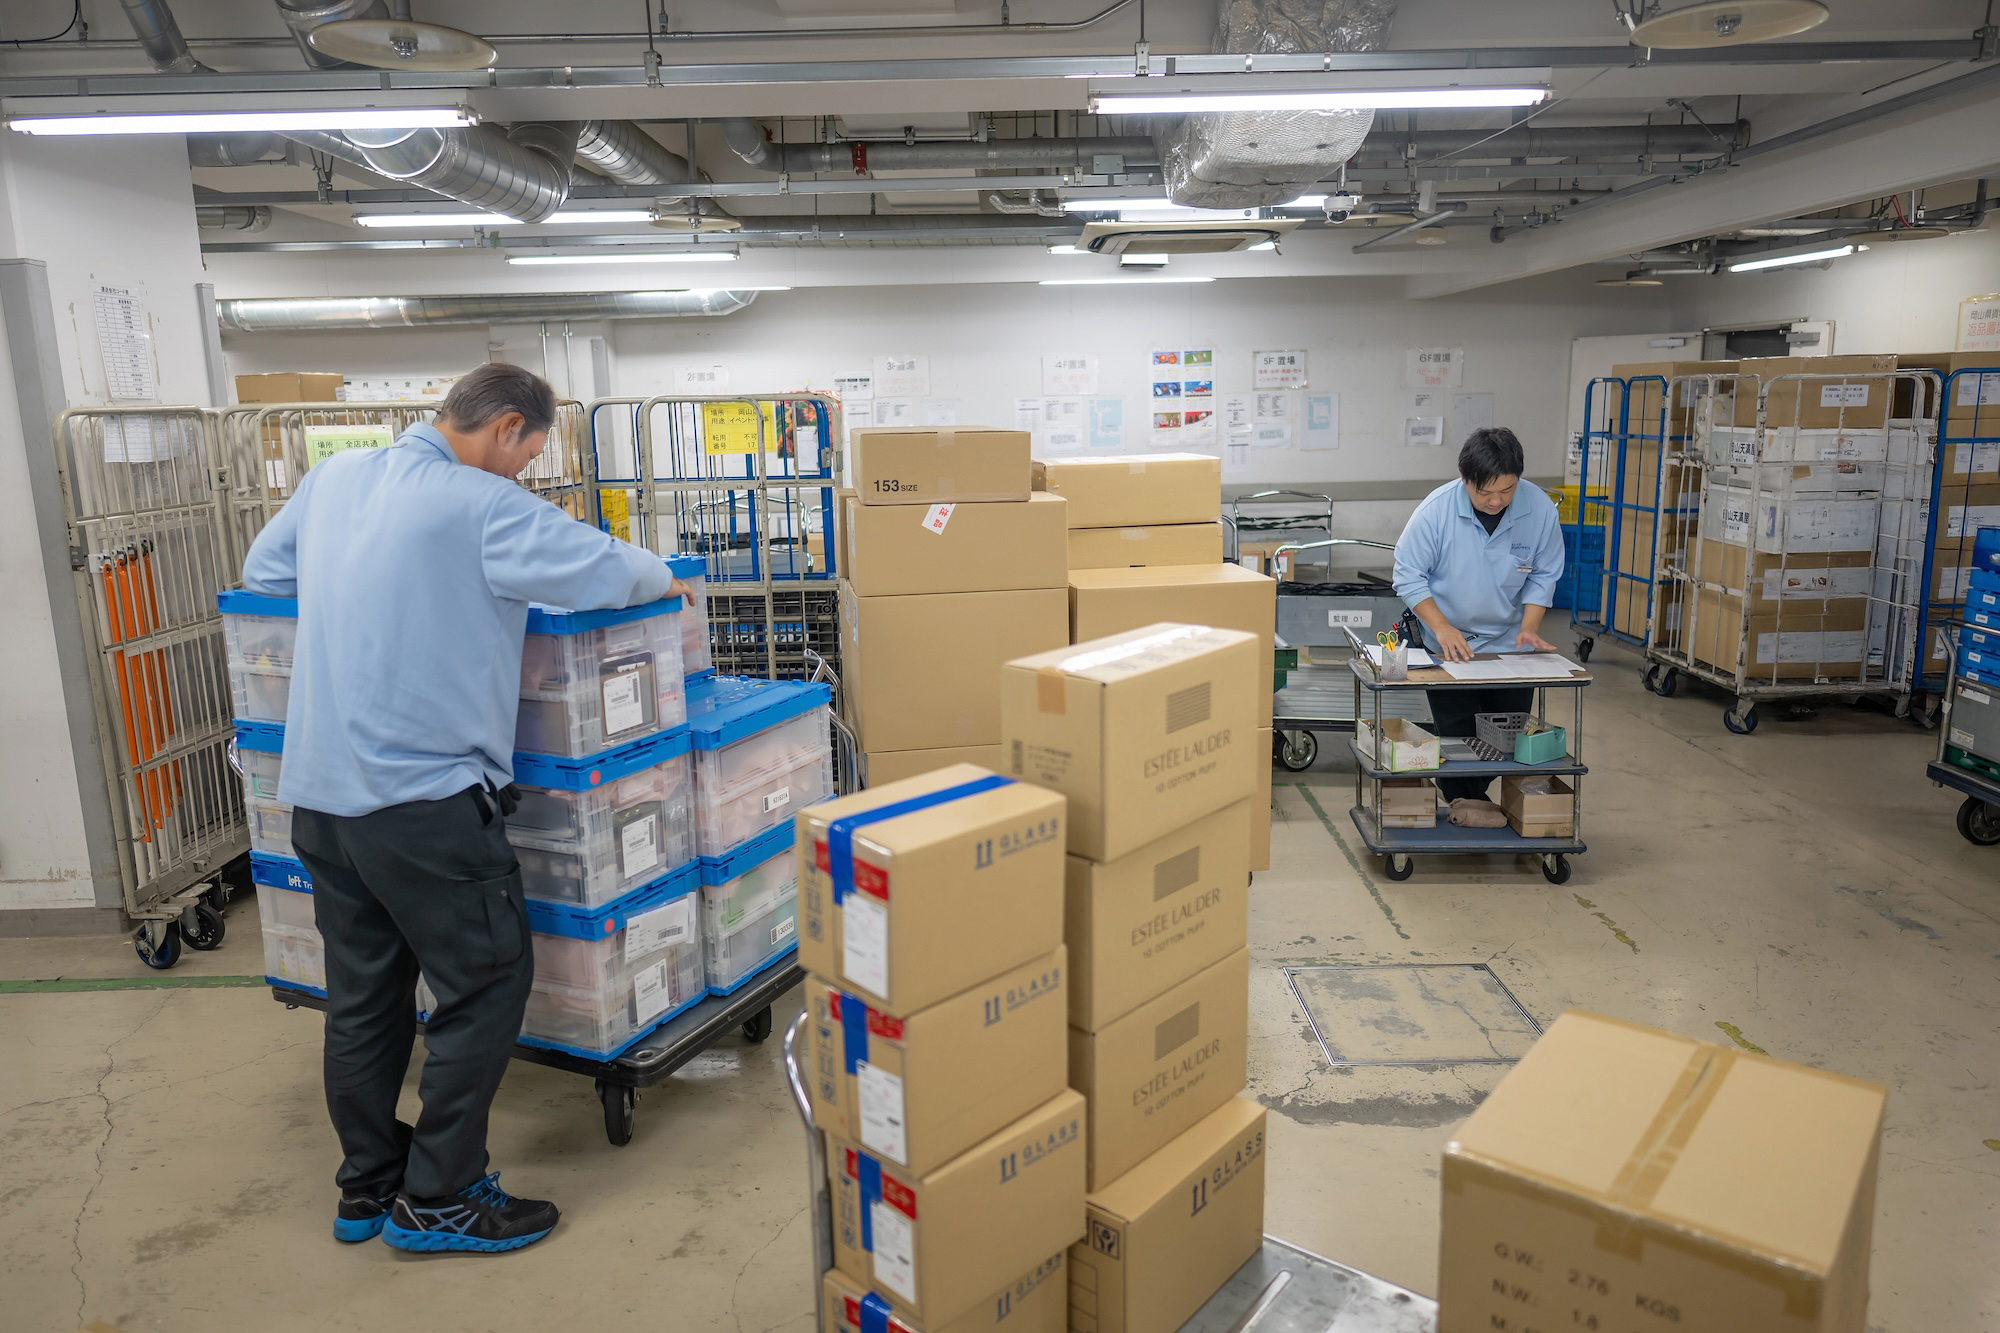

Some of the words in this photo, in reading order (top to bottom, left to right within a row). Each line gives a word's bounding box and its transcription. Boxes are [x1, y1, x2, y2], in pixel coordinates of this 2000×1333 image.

[1970, 309, 2000, 320] 岡山県貨
[1264, 357, 1274, 366] 5F
[1277, 356, 1296, 366] 置場
[710, 408, 724, 416] 場所
[318, 441, 334, 449] 場所
[345, 440, 378, 448] 全店共通
[712, 434, 726, 442] 転用
[713, 442, 726, 450] 番号
[874, 480, 900, 492] 153
[900, 484, 918, 492] SIZE
[1333, 615, 1349, 623] 監理
[1143, 744, 1181, 778] ESTÉE
[1184, 728, 1232, 762] LAUDER
[1166, 768, 1197, 790] COTTON
[1198, 761, 1218, 774] PUFF
[999, 818, 1059, 849] GLASS
[1172, 887, 1221, 925] LAUDER
[1154, 930, 1186, 954] COTTON
[1006, 967, 1060, 1004] GLASS
[1173, 1038, 1220, 1081] LAUDER
[1155, 1085, 1186, 1111] COTTON
[1023, 1119, 1079, 1159] GLASS
[1212, 1131, 1262, 1184] GLASS
[1633, 1292, 1683, 1324] KGS
